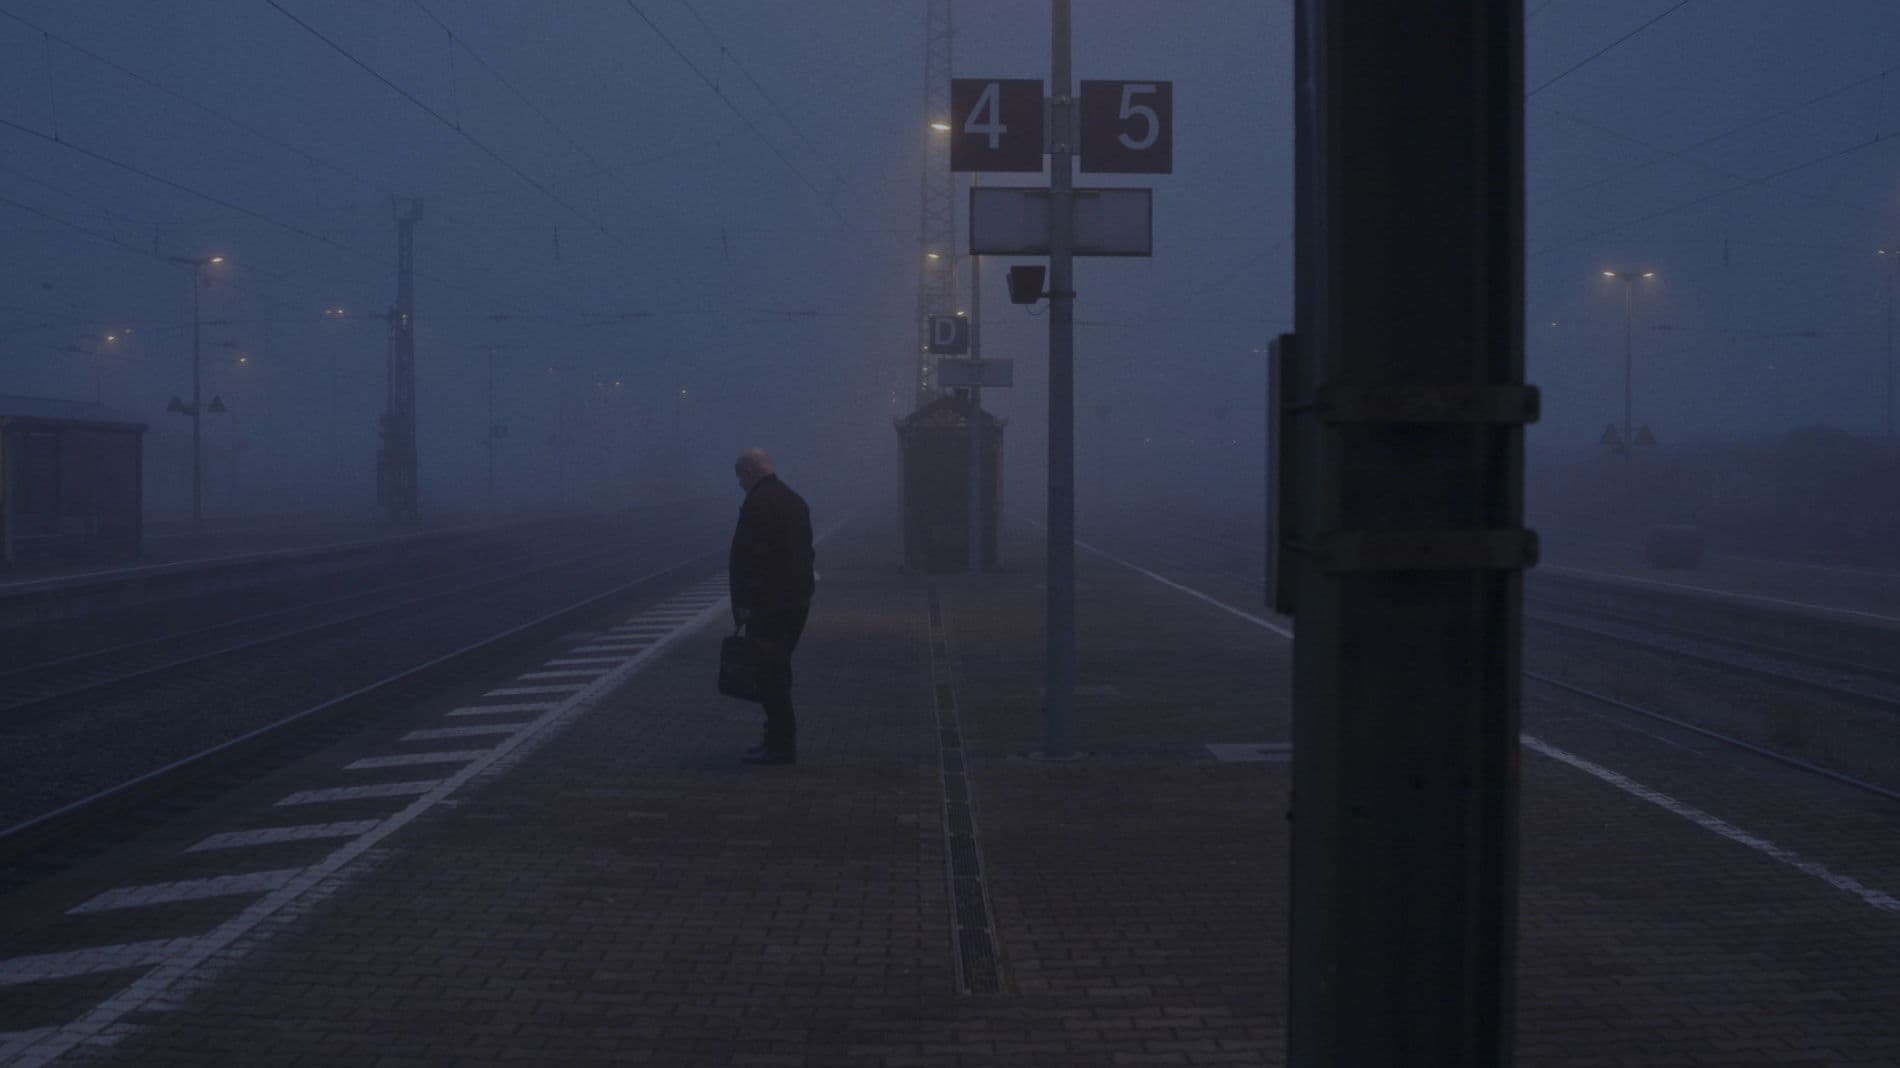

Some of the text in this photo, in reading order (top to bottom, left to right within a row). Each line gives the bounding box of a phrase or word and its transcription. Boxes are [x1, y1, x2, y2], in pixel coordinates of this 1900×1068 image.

[964, 83, 1007, 149] 4
[1117, 84, 1160, 150] 5
[935, 319, 956, 344] D
